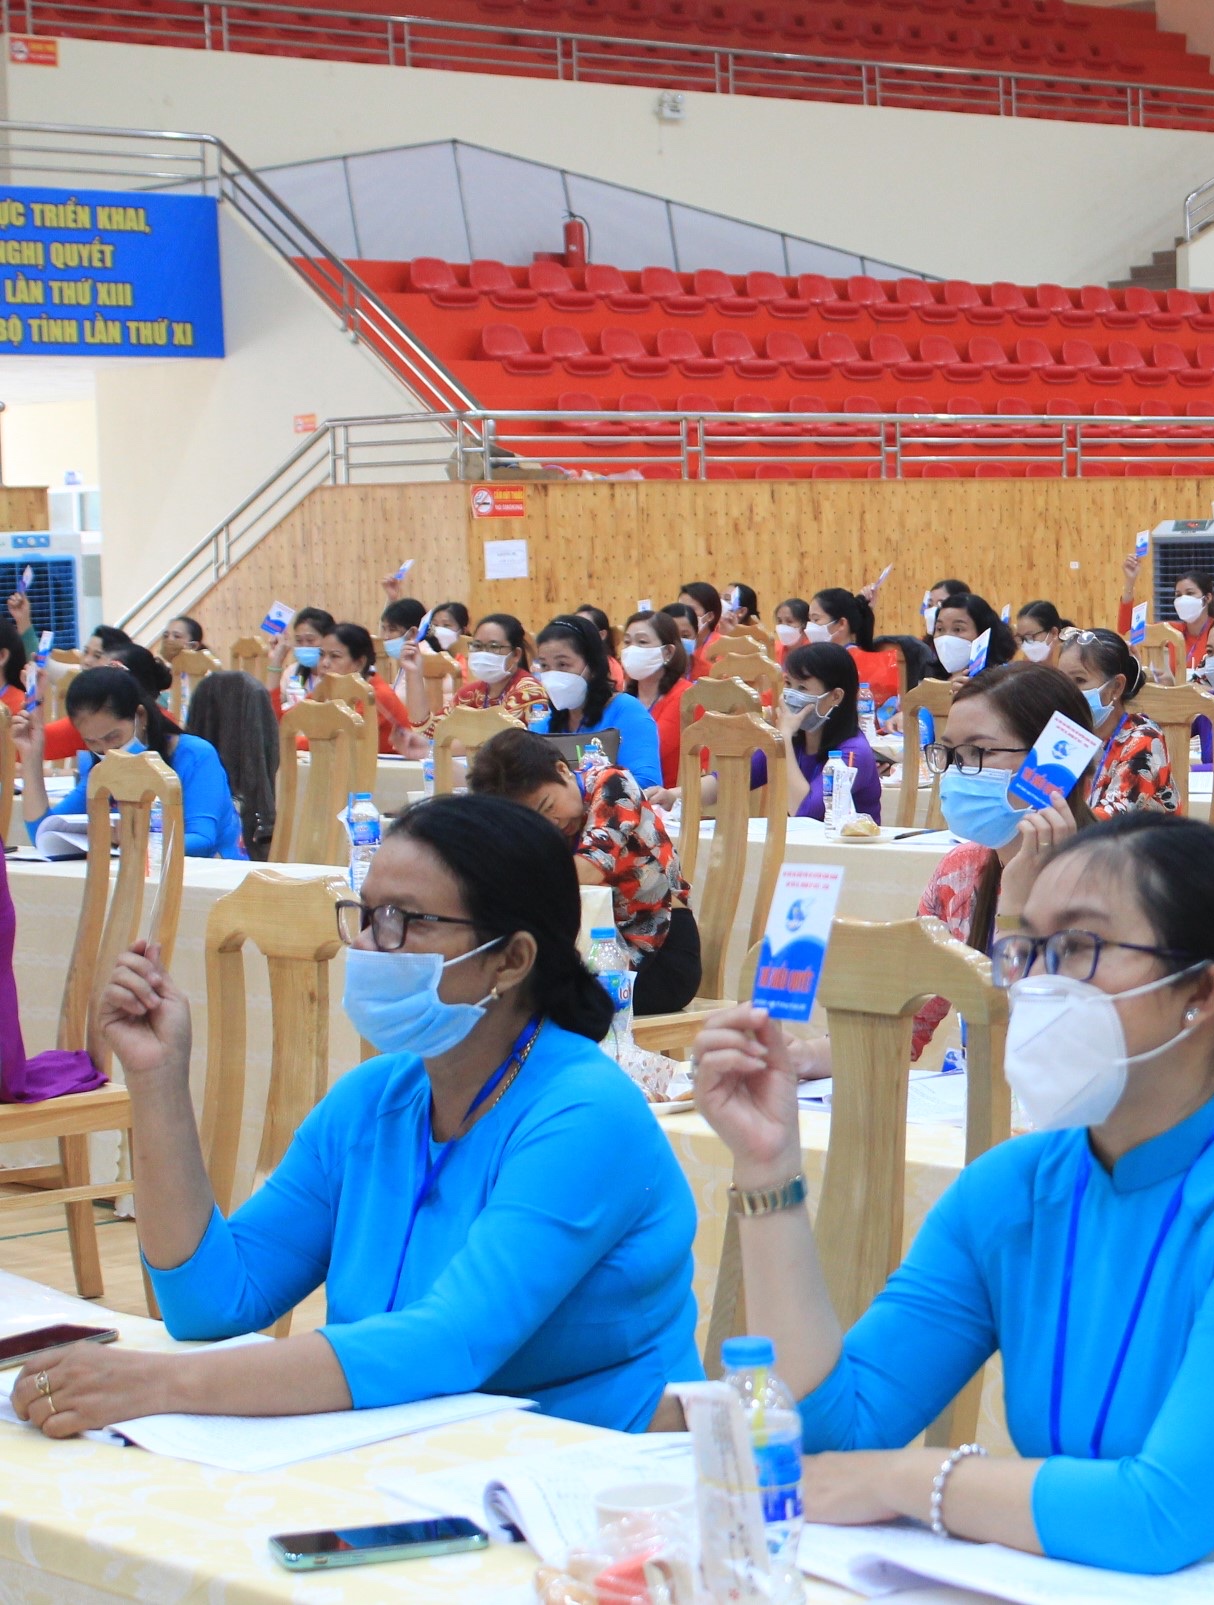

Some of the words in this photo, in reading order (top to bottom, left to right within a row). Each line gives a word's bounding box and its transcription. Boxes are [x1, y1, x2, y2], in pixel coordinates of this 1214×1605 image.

[30, 196, 92, 229] TRIỂN
[95, 205, 151, 235] KHAI,
[49, 236, 115, 269] QUYẾT
[4, 271, 45, 304] LẦN
[49, 278, 94, 305] THỨ
[96, 282, 133, 307] XIII
[28, 313, 78, 343] TỈNH
[83, 311, 122, 344] LẦN
[126, 318, 169, 346] THỨ
[172, 323, 194, 346] XI
